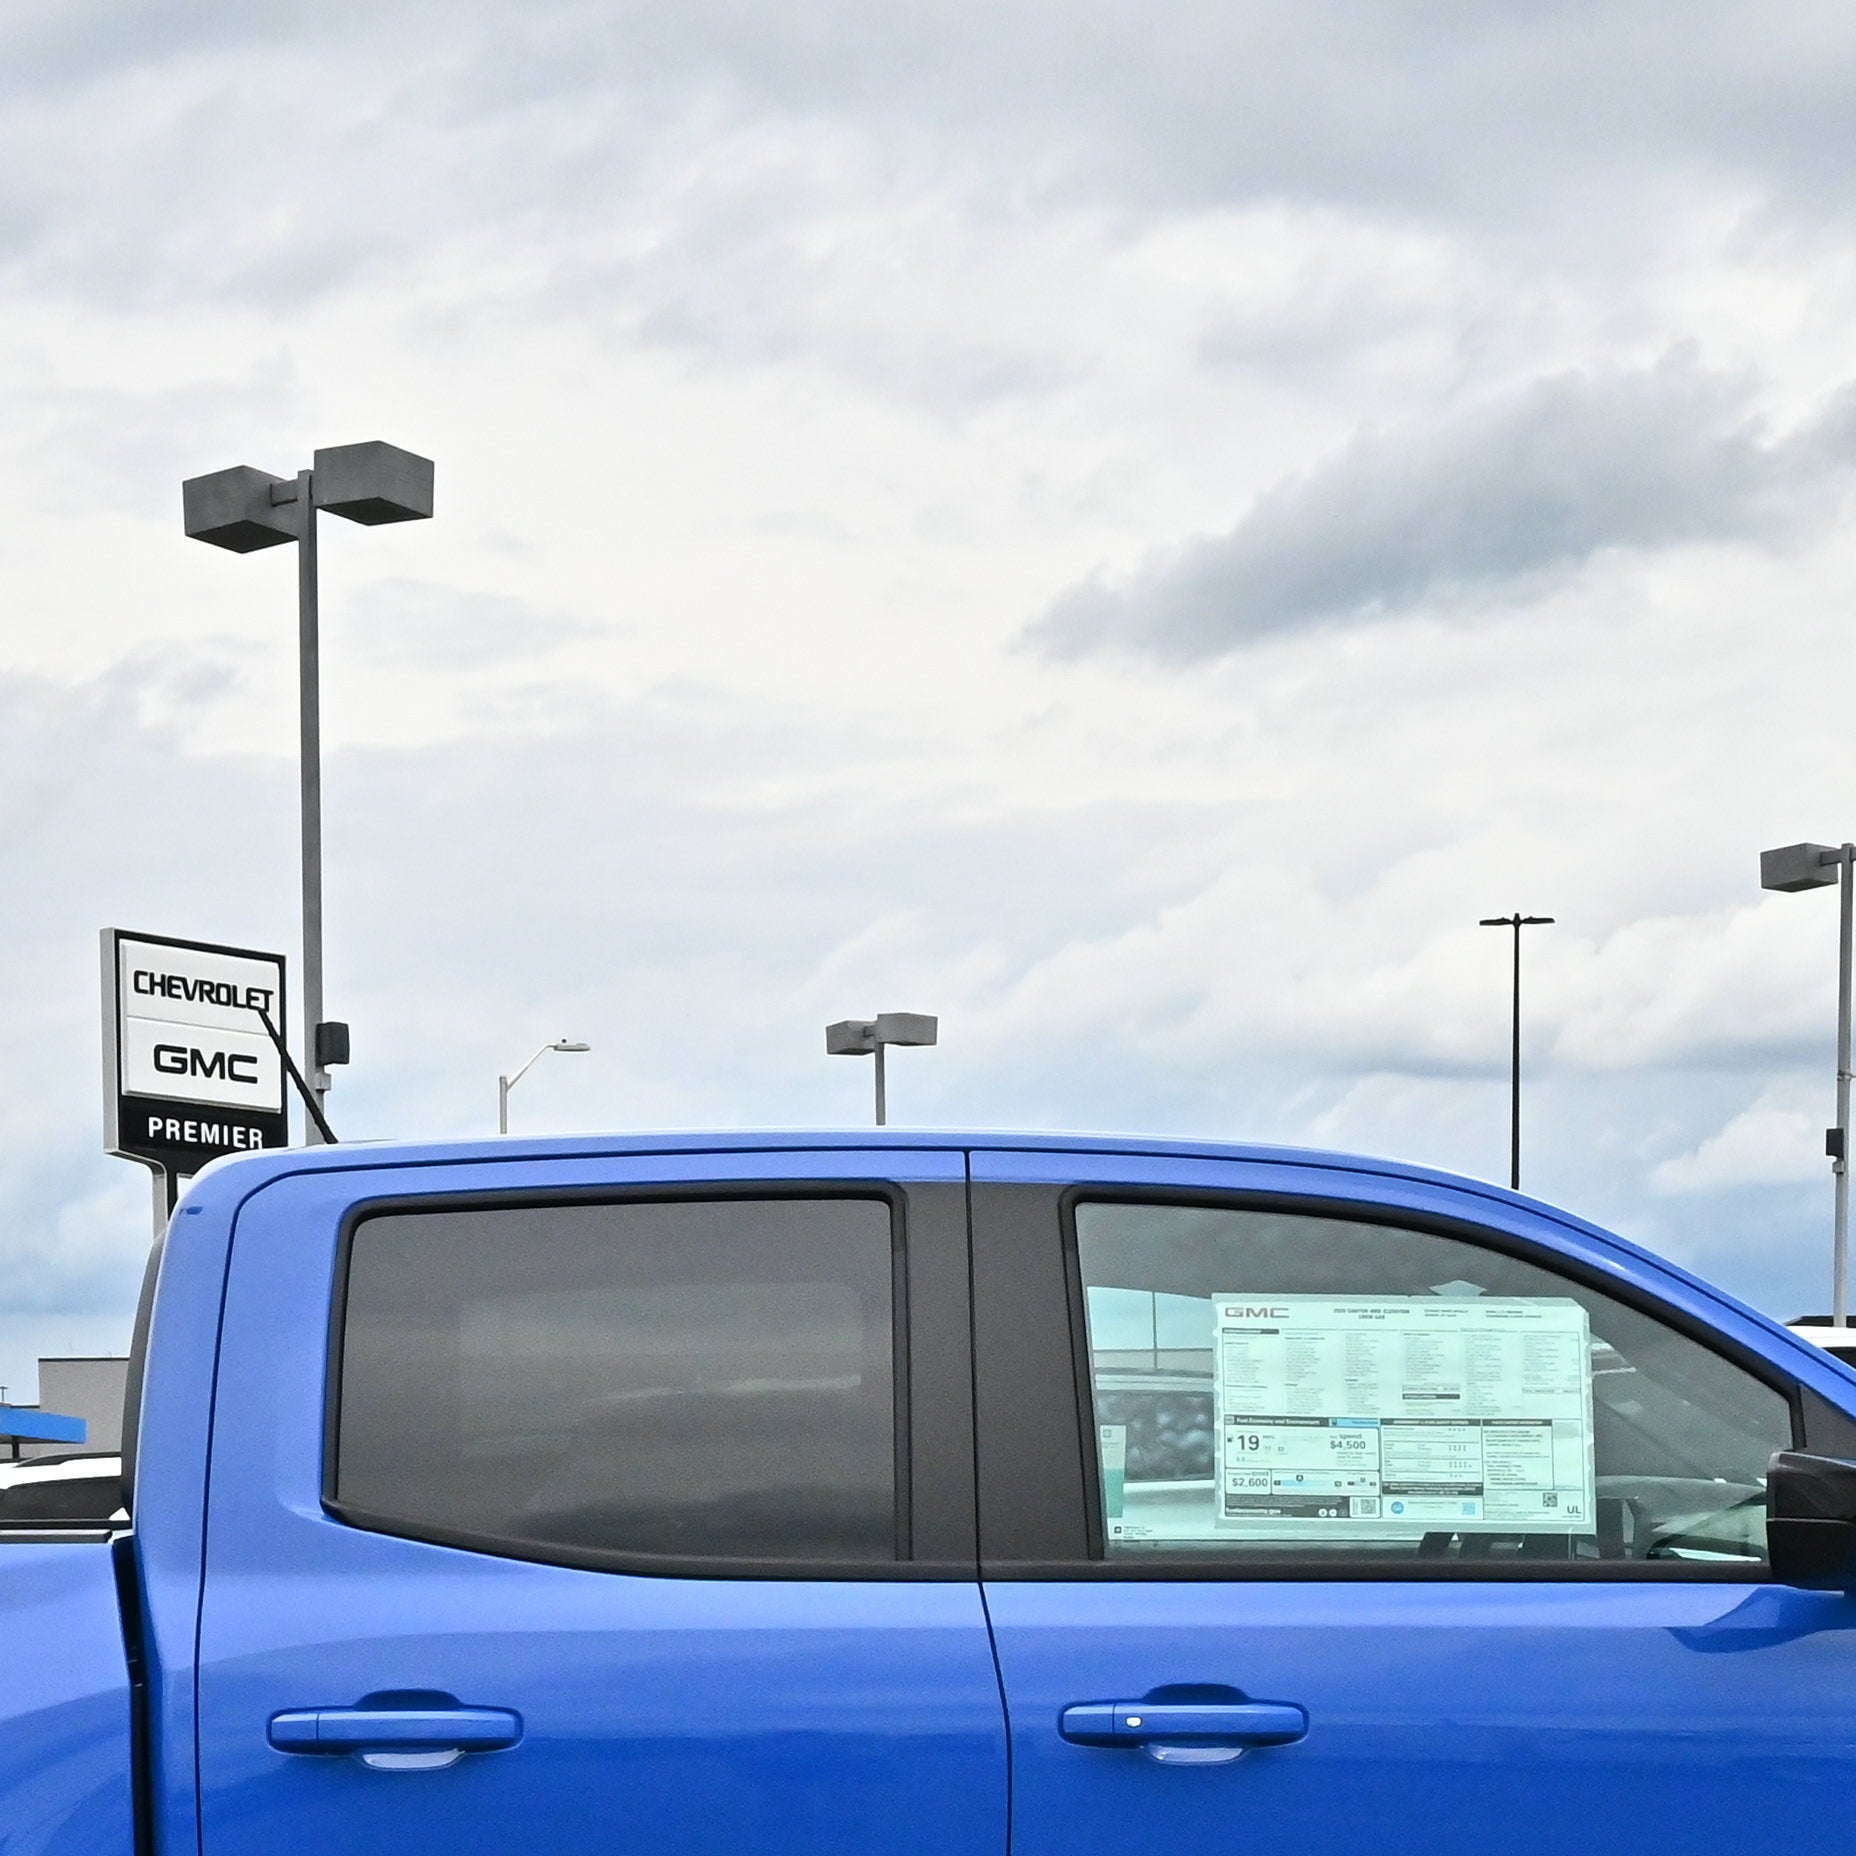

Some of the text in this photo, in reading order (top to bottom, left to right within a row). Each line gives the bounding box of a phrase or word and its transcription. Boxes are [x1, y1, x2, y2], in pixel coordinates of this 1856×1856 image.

[133, 969, 274, 1012] CHEVROLET
[153, 1044, 258, 1084] GMC
[148, 1116, 263, 1149] PREMIER
[1224, 1307, 1290, 1319] GMC
[1237, 1434, 1260, 1451] 19
[1330, 1440, 1366, 1450] $4,500
[1232, 1477, 1268, 1487] $2,600
